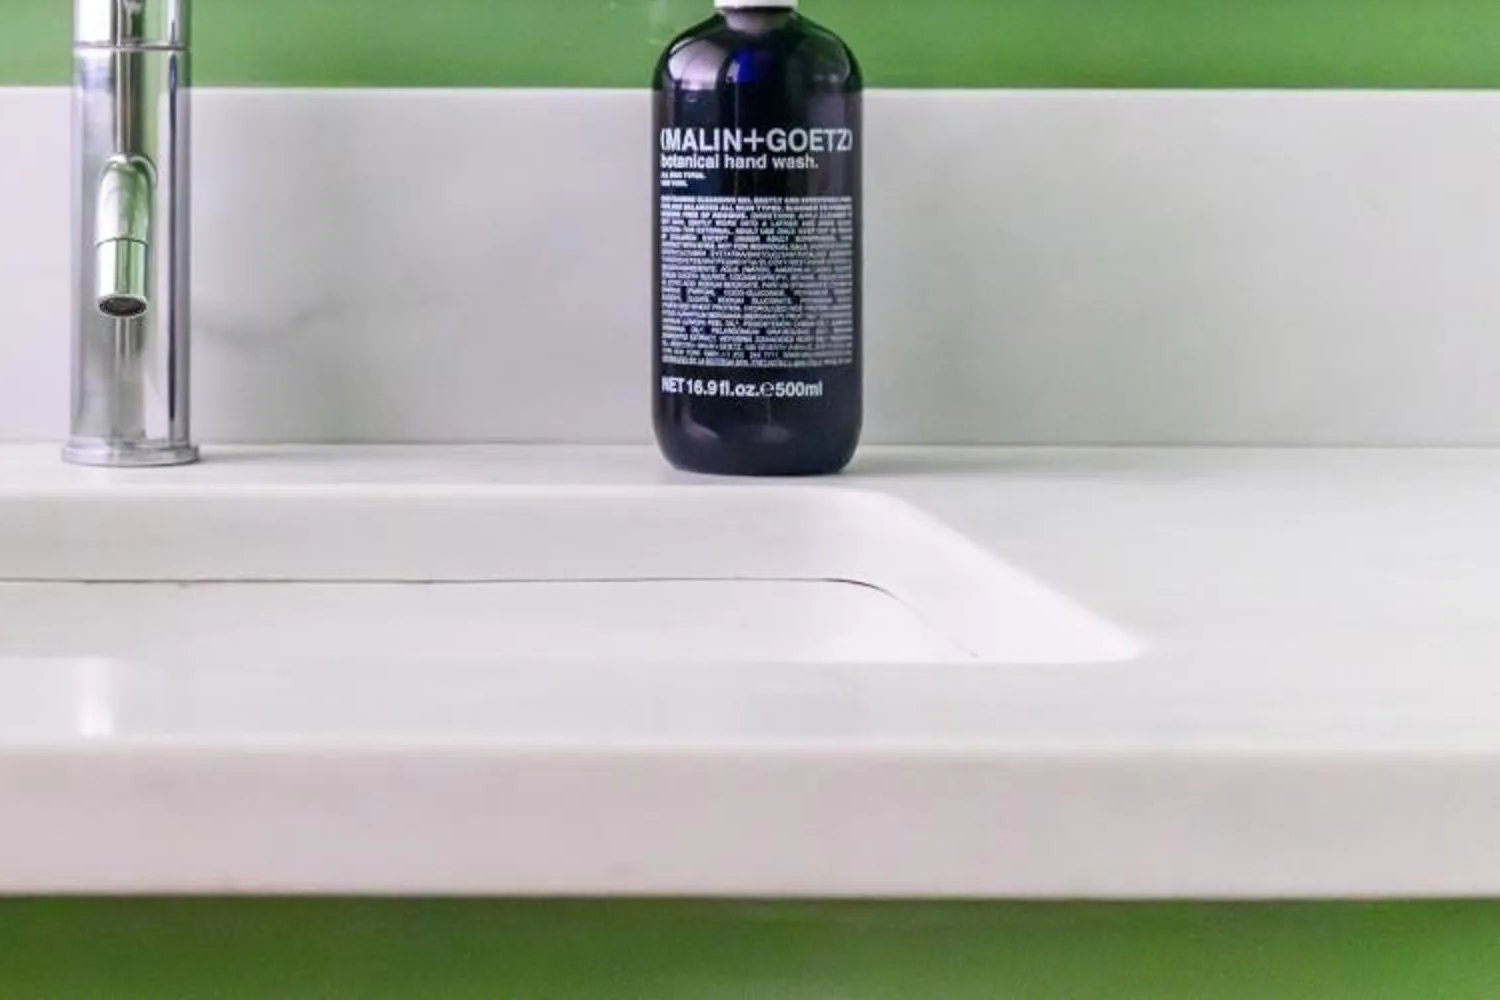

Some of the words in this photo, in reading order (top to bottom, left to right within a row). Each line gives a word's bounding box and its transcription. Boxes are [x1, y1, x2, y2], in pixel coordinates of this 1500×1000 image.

[660, 153, 719, 169] botanical
[723, 154, 767, 169] hand
[771, 154, 819, 169] wash.
[661, 376, 685, 393] NET
